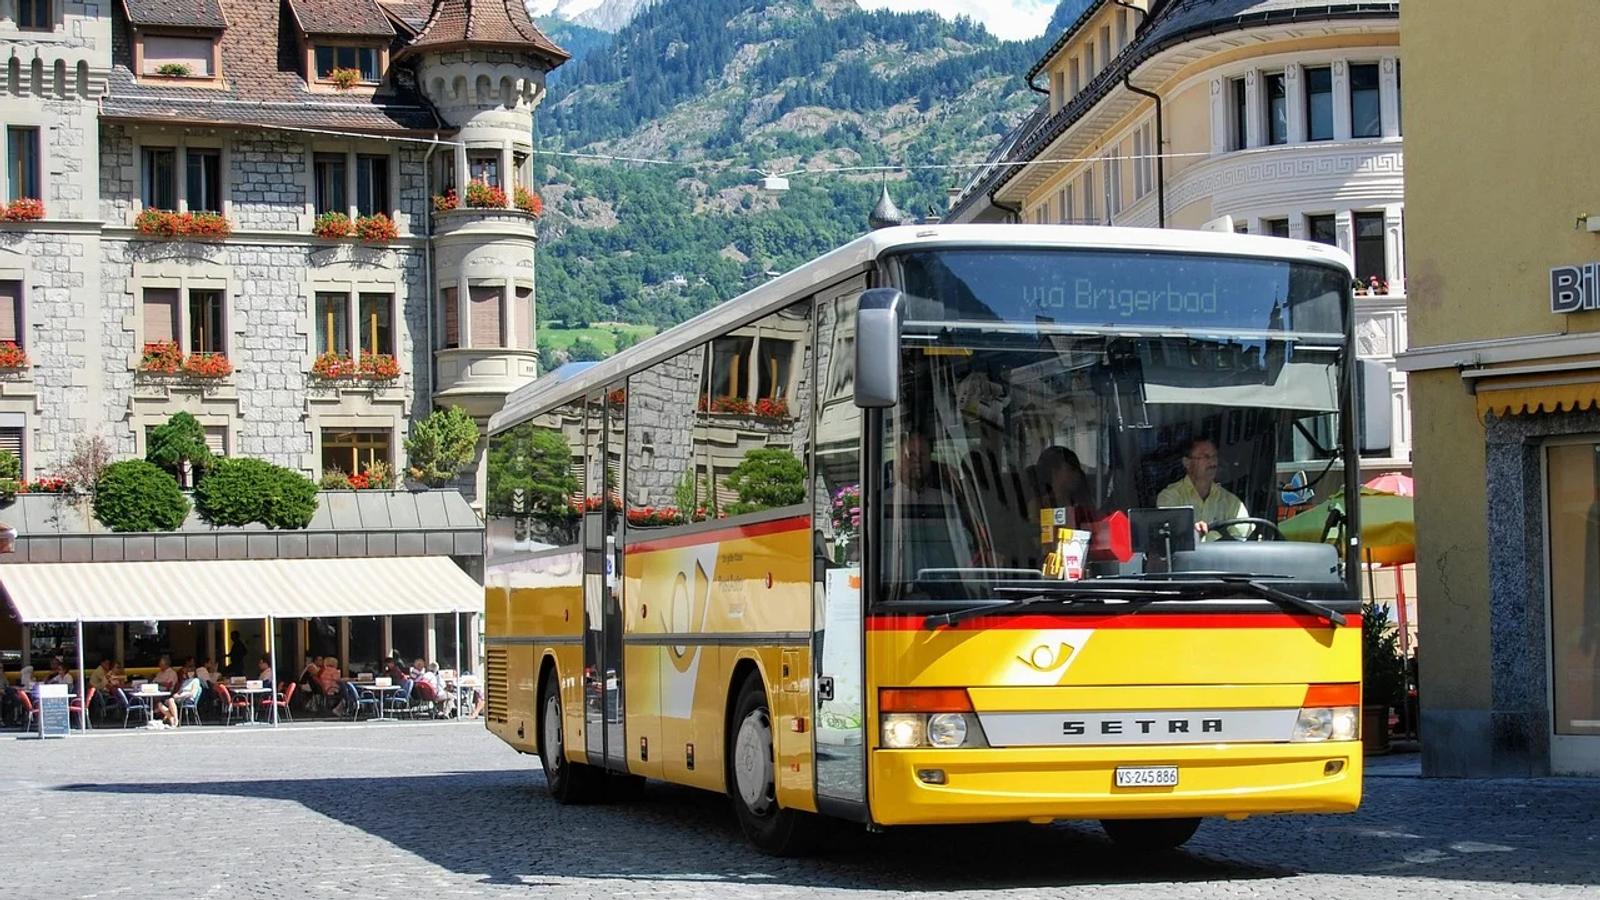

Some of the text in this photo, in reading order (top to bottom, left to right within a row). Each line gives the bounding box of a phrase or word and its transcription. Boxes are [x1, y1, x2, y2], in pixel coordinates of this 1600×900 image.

[1023, 278, 1217, 316] via Brigerbad
[1063, 719, 1222, 735] SETRA
